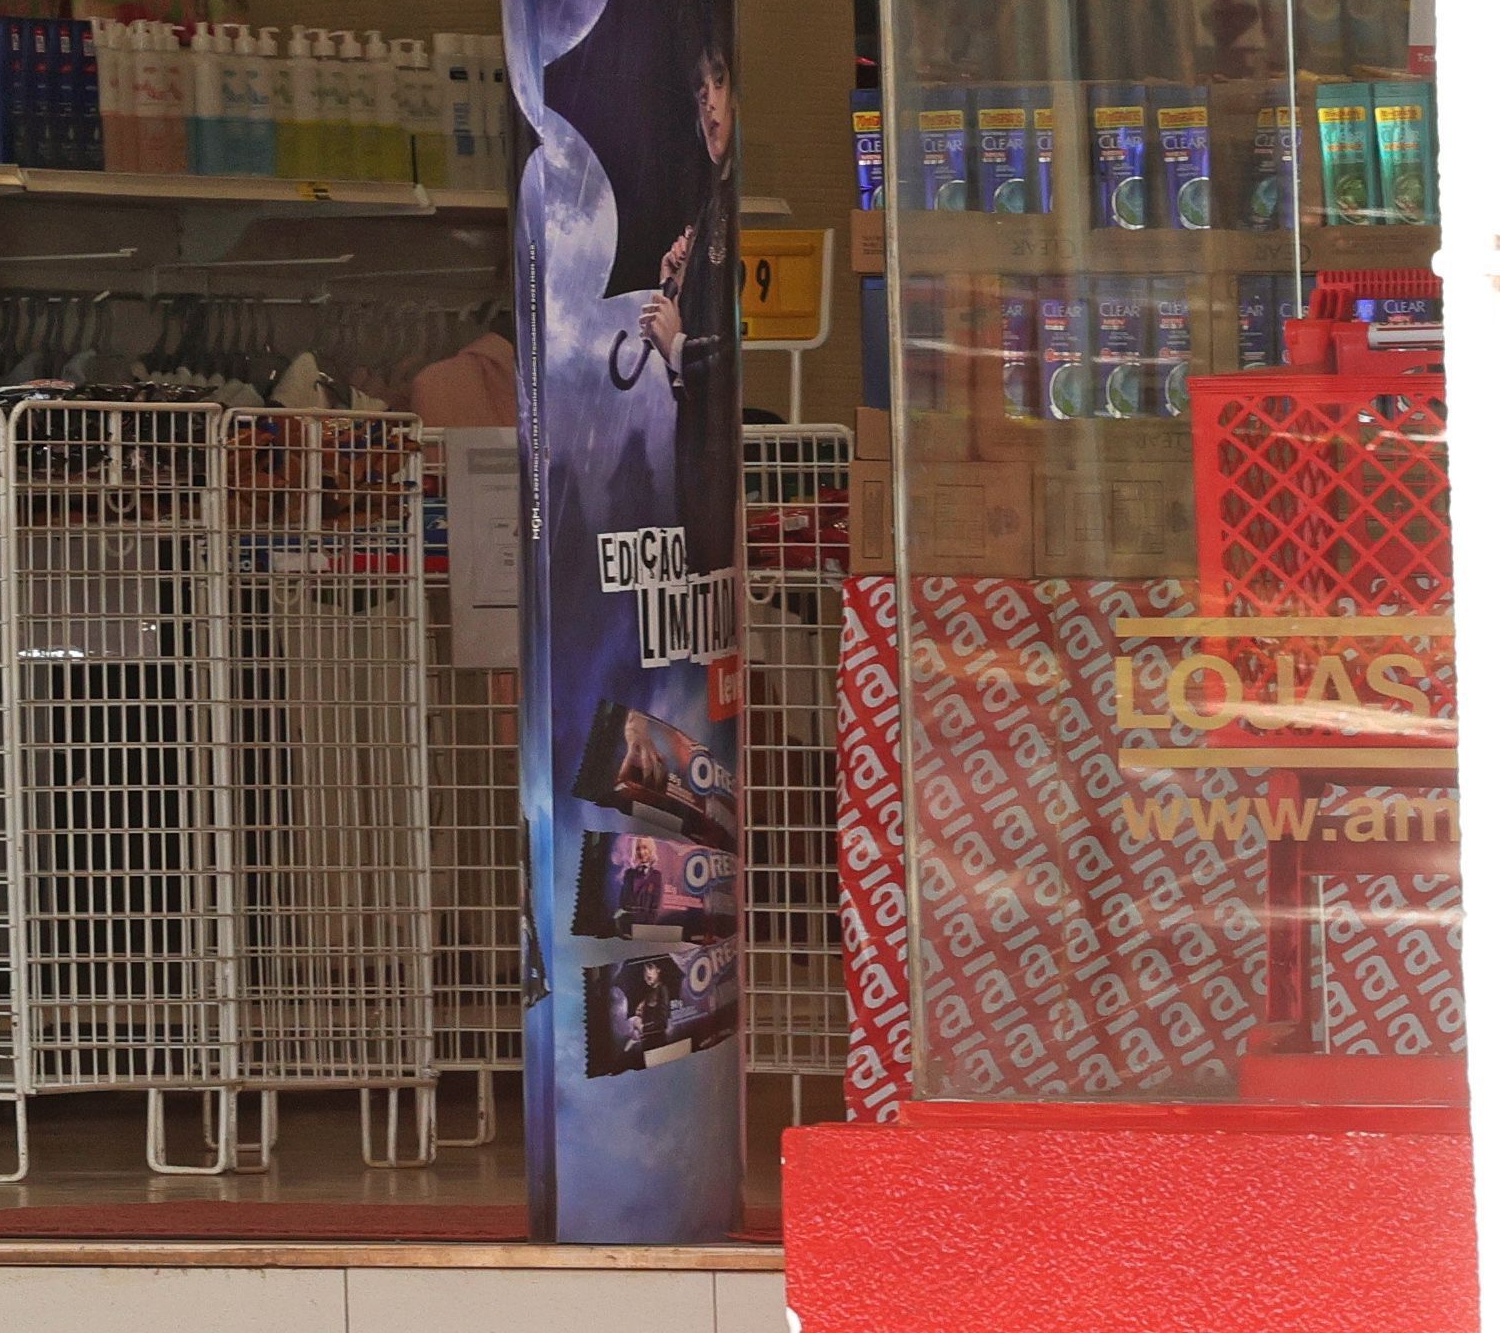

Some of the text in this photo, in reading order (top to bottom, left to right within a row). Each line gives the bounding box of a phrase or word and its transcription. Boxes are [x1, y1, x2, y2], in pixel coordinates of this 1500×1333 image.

[857, 137, 882, 153] CLE
[923, 138, 963, 152] CLEAR
[981, 136, 1024, 151] CLEAR
[1098, 134, 1143, 149] CLEAR
[1162, 135, 1208, 150] CLEAR
[1042, 302, 1084, 317] CLEAR
[1100, 302, 1141, 317] CLEAR
[1158, 301, 1189, 316] CLE
[1238, 304, 1265, 317] EAR
[1383, 299, 1426, 314] CLEAR
[602, 529, 684, 587] EDIÇÃO
[1116, 651, 1429, 732] LOJAS
